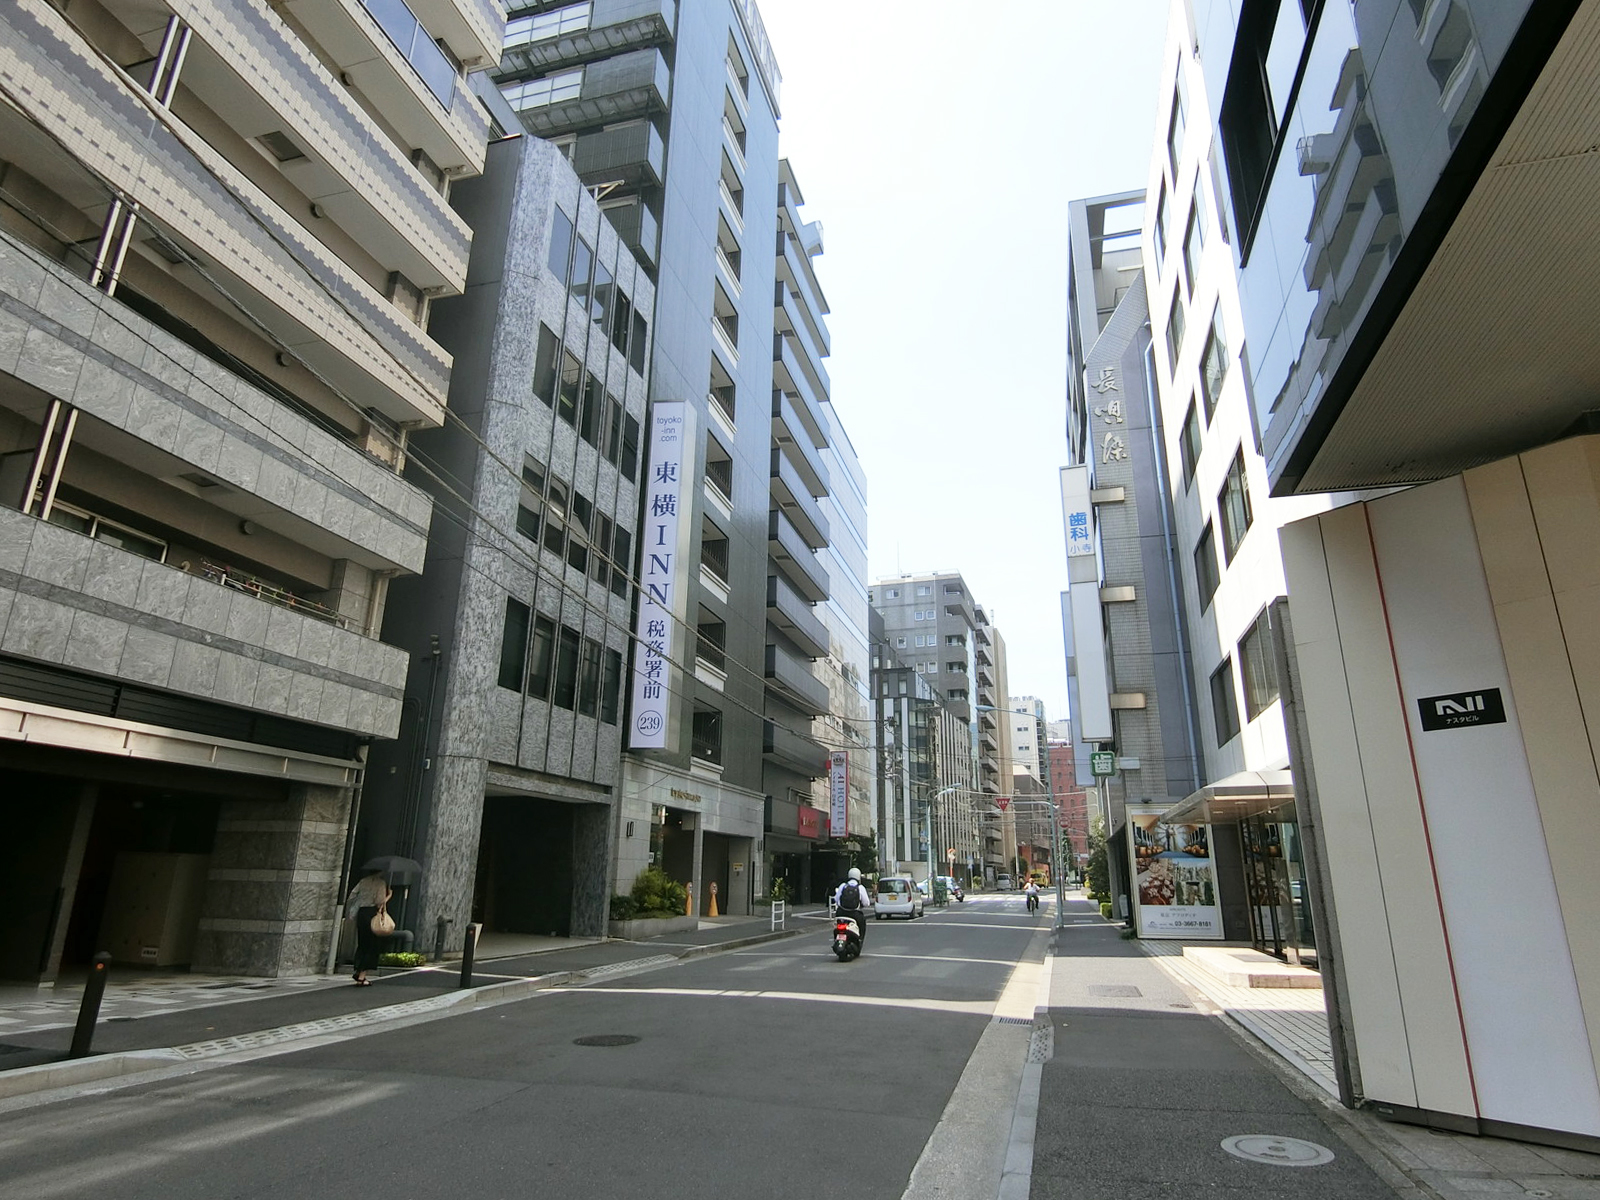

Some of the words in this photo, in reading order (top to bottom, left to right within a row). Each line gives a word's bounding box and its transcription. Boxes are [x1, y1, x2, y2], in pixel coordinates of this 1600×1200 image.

[656, 415, 682, 425] toyoko
[1068, 511, 1089, 542] 歯科
[638, 714, 661, 732] 239
[1445, 715, 1480, 725] ナスタビル
[837, 787, 845, 822] HOTEL
